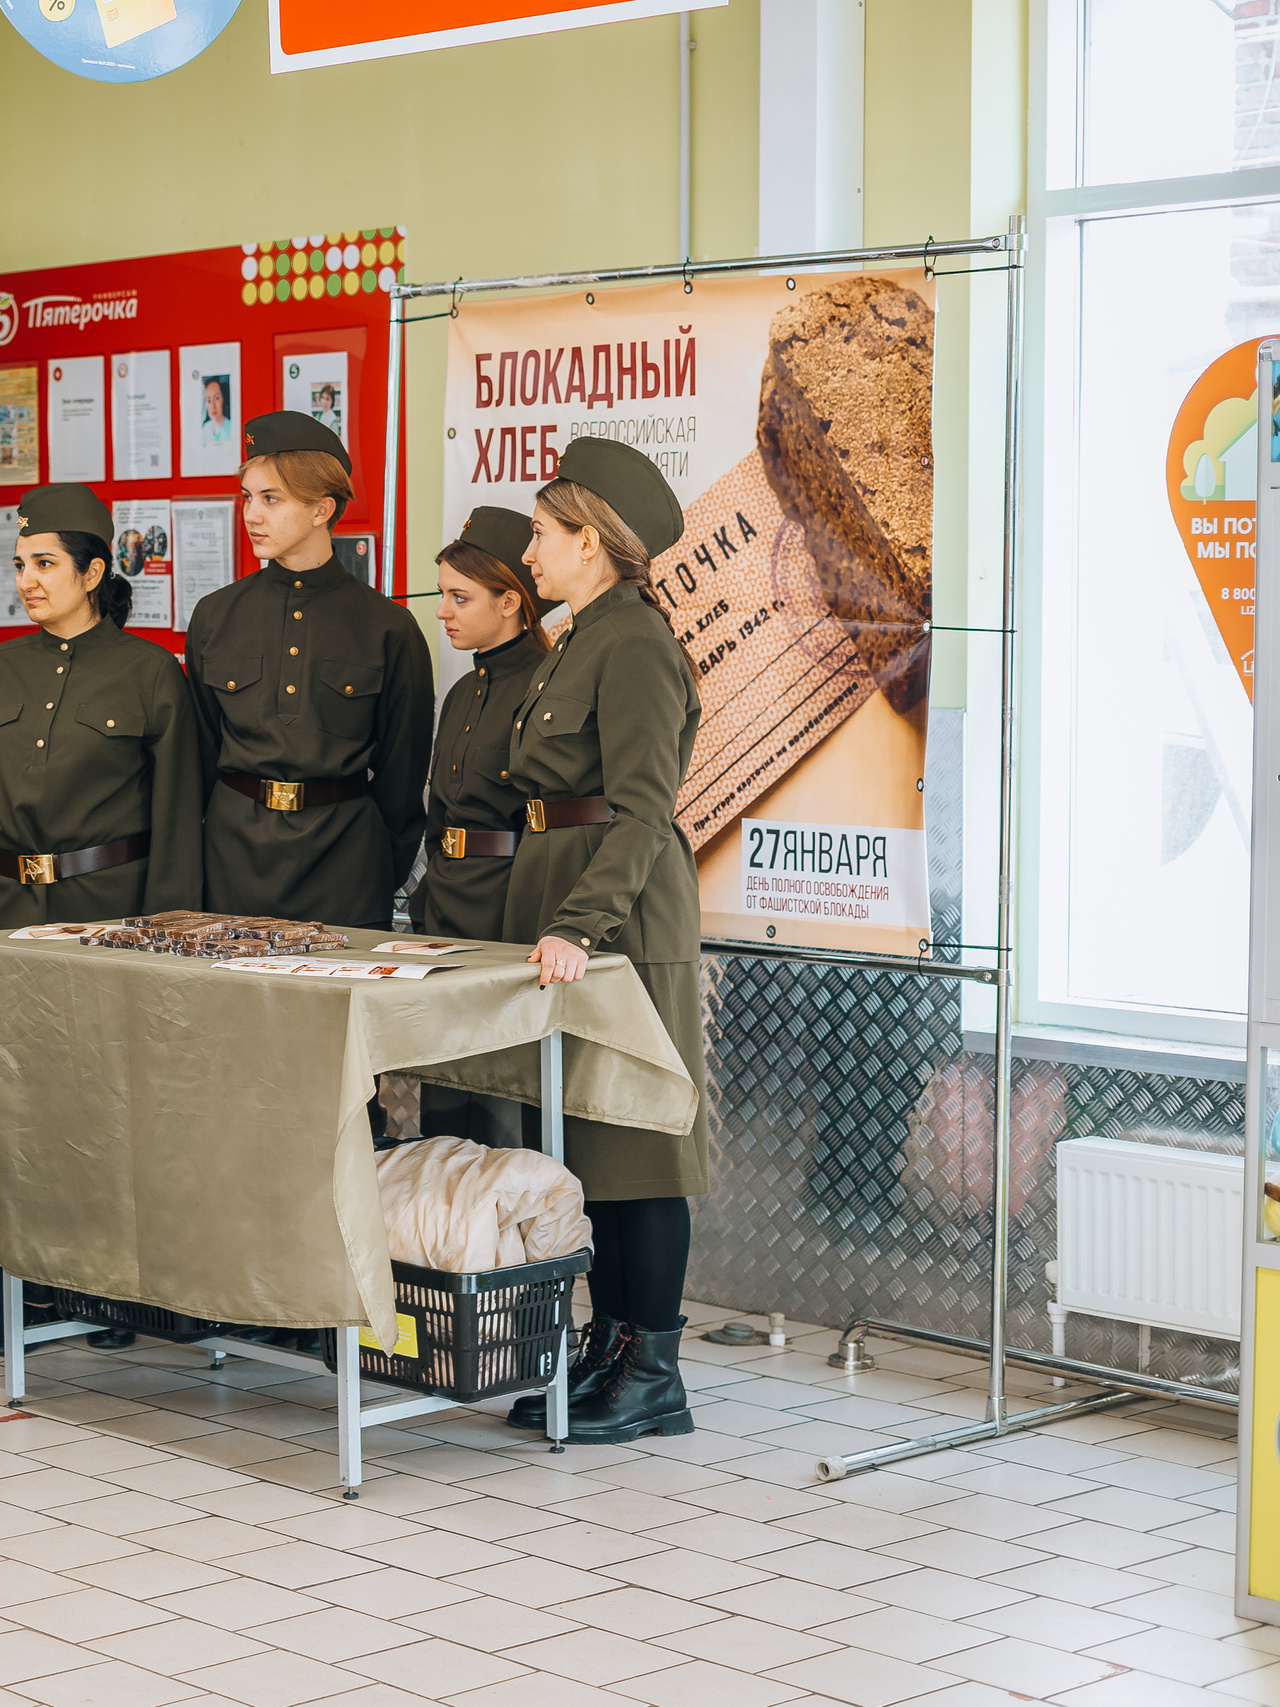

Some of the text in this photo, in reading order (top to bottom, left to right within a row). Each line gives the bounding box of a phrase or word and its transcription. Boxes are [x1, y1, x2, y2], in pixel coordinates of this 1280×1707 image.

[22, 295, 138, 331] Пятерочка
[475, 324, 696, 410] БЛОКАДНЫЙ
[570, 414, 697, 445] ВСЕРОССИЙСКАЯ
[470, 424, 560, 483] ХЛЕБ
[1191, 517, 1218, 535] ВЫ
[1197, 541, 1230, 559] МЫ
[1221, 587, 1256, 600] 8 800
[696, 599, 729, 633] ХЛЕБ
[738, 608, 771, 640] 1942
[772, 600, 785, 612] г.
[693, 814, 711, 832] При
[737, 756, 775, 793] карточка
[776, 745, 787, 758] не
[746, 876, 889, 901] ДЕНЬ ПОЛНОГО ОСВОБОЖДЕНИЯ
[746, 895, 869, 919] ОТ ФАШИСТСКОЙ БЛОКАДЫ
